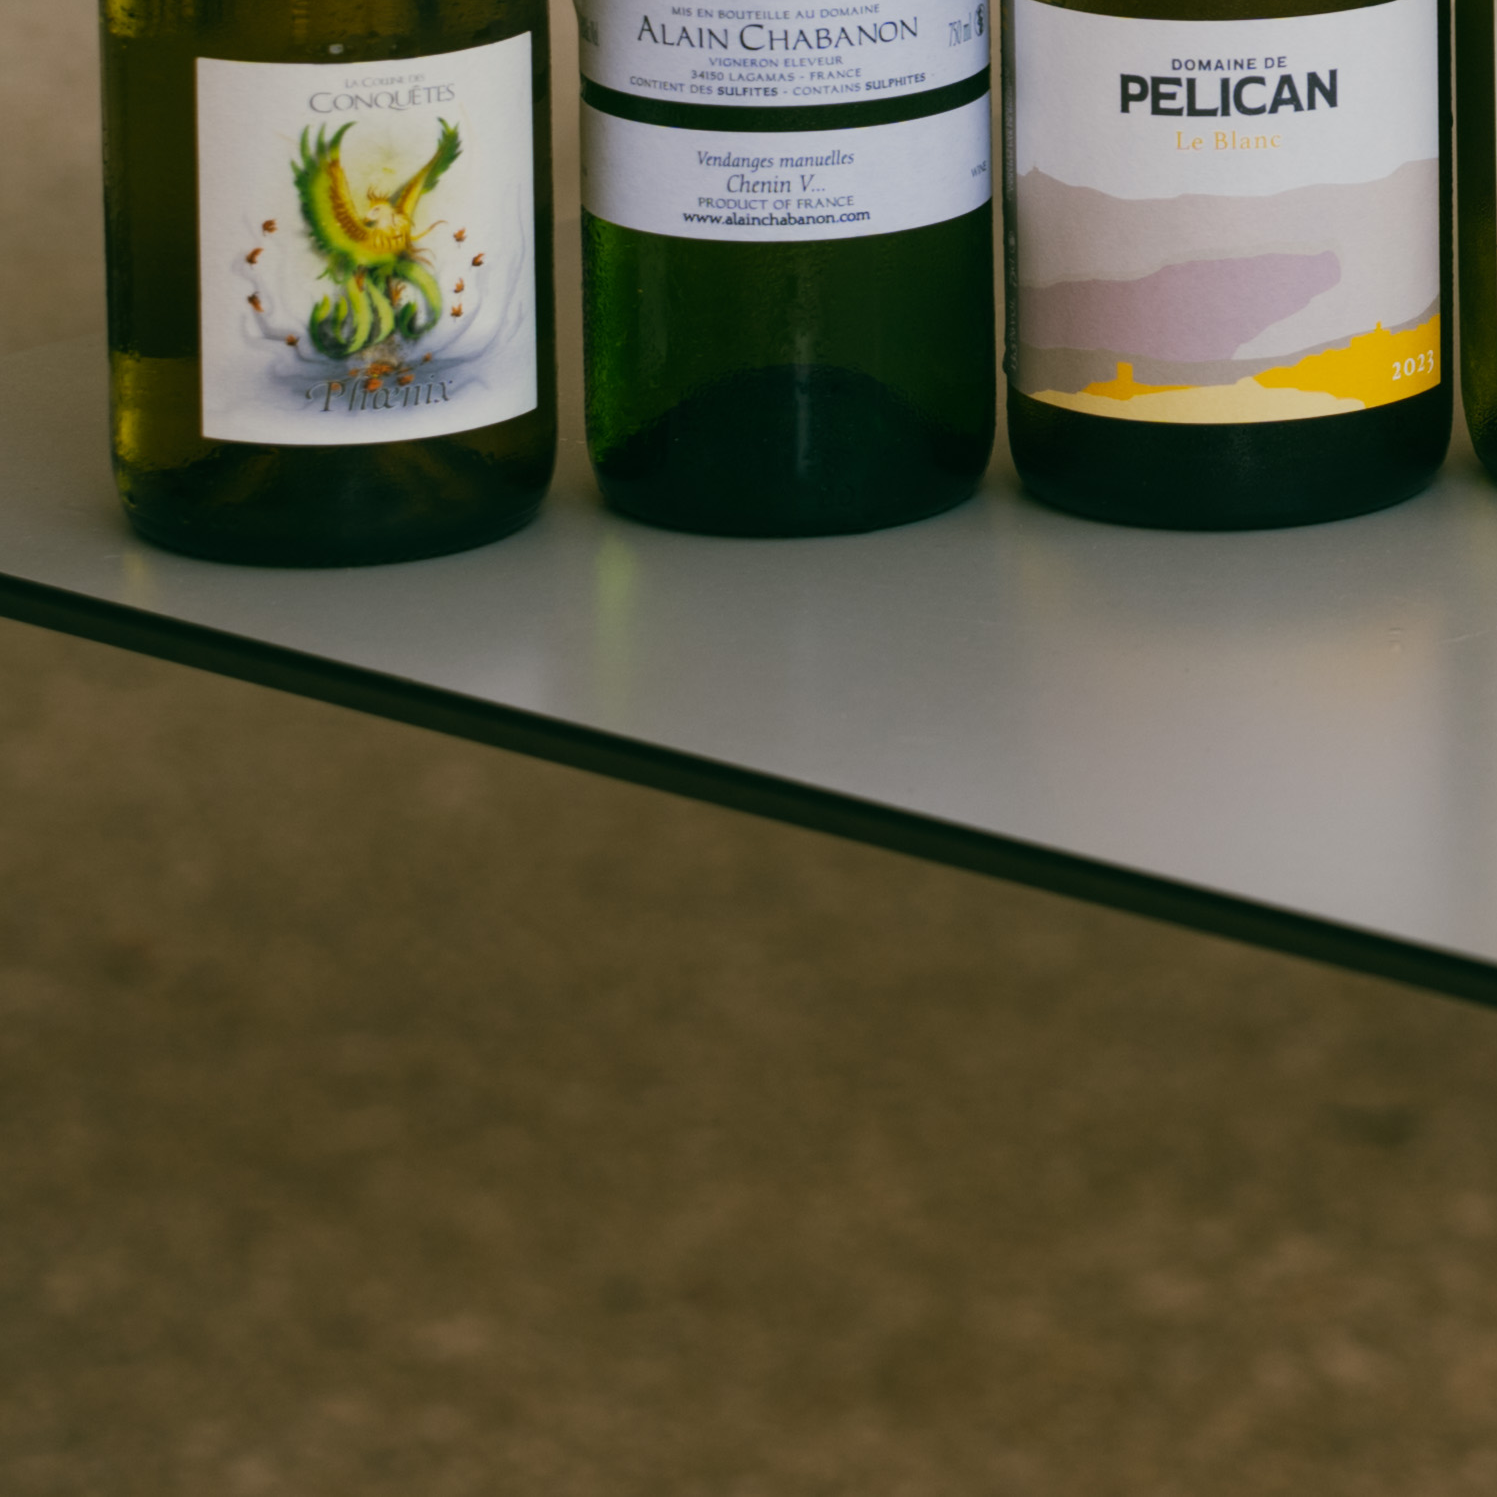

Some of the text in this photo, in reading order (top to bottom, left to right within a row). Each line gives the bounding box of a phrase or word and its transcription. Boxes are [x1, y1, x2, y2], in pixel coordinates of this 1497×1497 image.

[671, 3, 880, 21] MIS EN BOUTEILLE AU DOMAINE
[637, 15, 728, 51] ALAIN
[739, 15, 918, 52] CHABANON
[709, 55, 843, 68] VIGNERON ELEVEUR
[1171, 56, 1288, 72] DOMAINE DE
[691, 69, 725, 82] 34150
[729, 71, 795, 83] LAGAMAS
[810, 67, 862, 80] FRANCE
[629, 75, 686, 94] CONTIENT
[689, 82, 713, 96] DES
[716, 86, 778, 98] SULFITES
[793, 83, 861, 97] CONTAINS
[864, 72, 926, 92] SULPHITES
[1119, 68, 1338, 117] PELICAN
[308, 82, 456, 114] CONQUÊTES
[1175, 129, 1283, 151] Le Blanc
[697, 150, 855, 169] Vendanges manuelles
[726, 174, 792, 194] Chenin
[697, 195, 854, 211] PRODUCT OF FRANCE
[682, 208, 871, 227] www.alainchabanon.com
[1391, 349, 1435, 382] 2023
